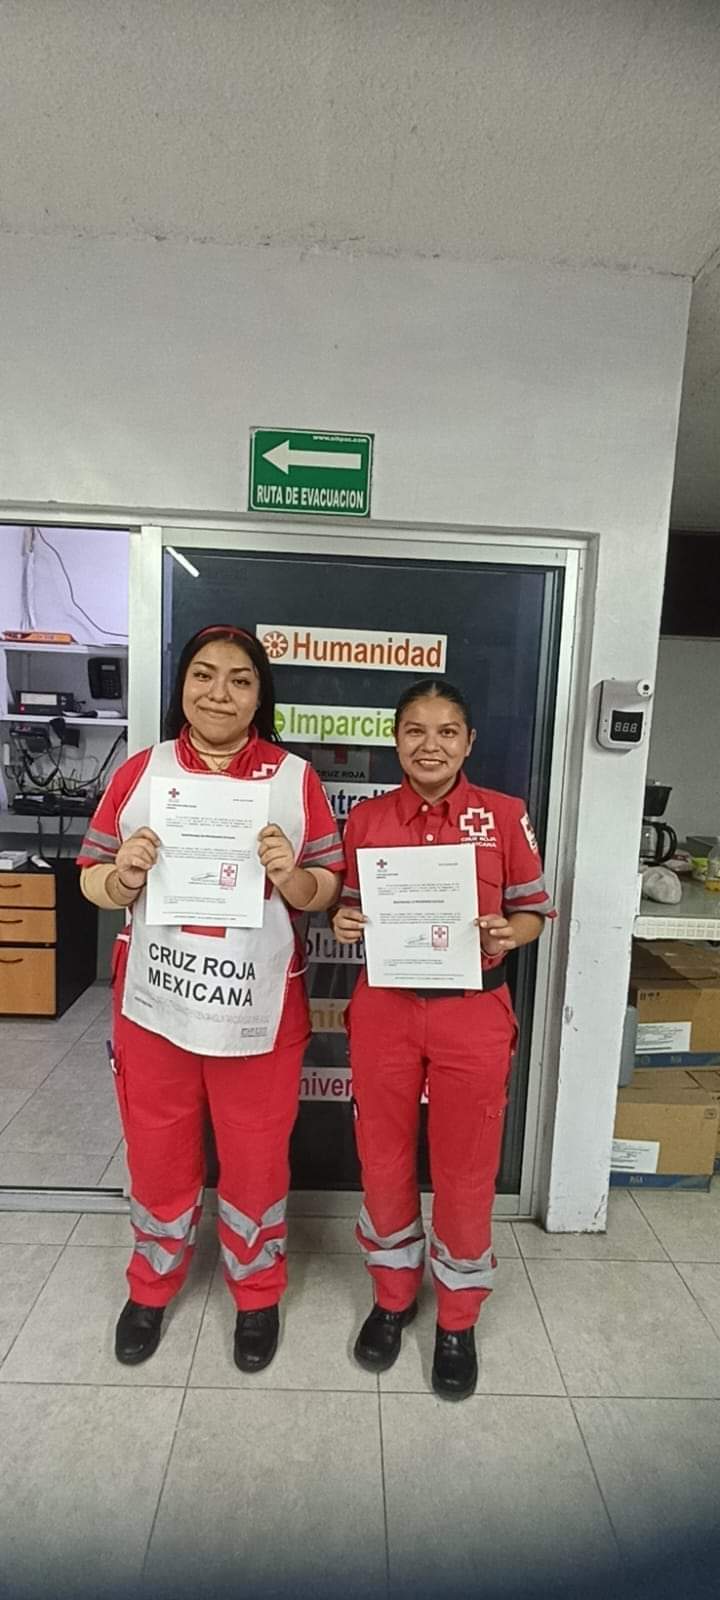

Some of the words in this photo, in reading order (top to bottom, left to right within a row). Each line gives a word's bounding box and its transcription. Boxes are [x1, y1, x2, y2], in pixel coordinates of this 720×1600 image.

[257, 485, 283, 504] RUTA
[285, 486, 299, 505] DE
[301, 487, 364, 509] EVACUACION
[293, 632, 442, 668] Humanidad
[149, 943, 196, 973] CRUZ
[202, 957, 256, 980] ROJA
[148, 967, 253, 1007] MEXICANA
